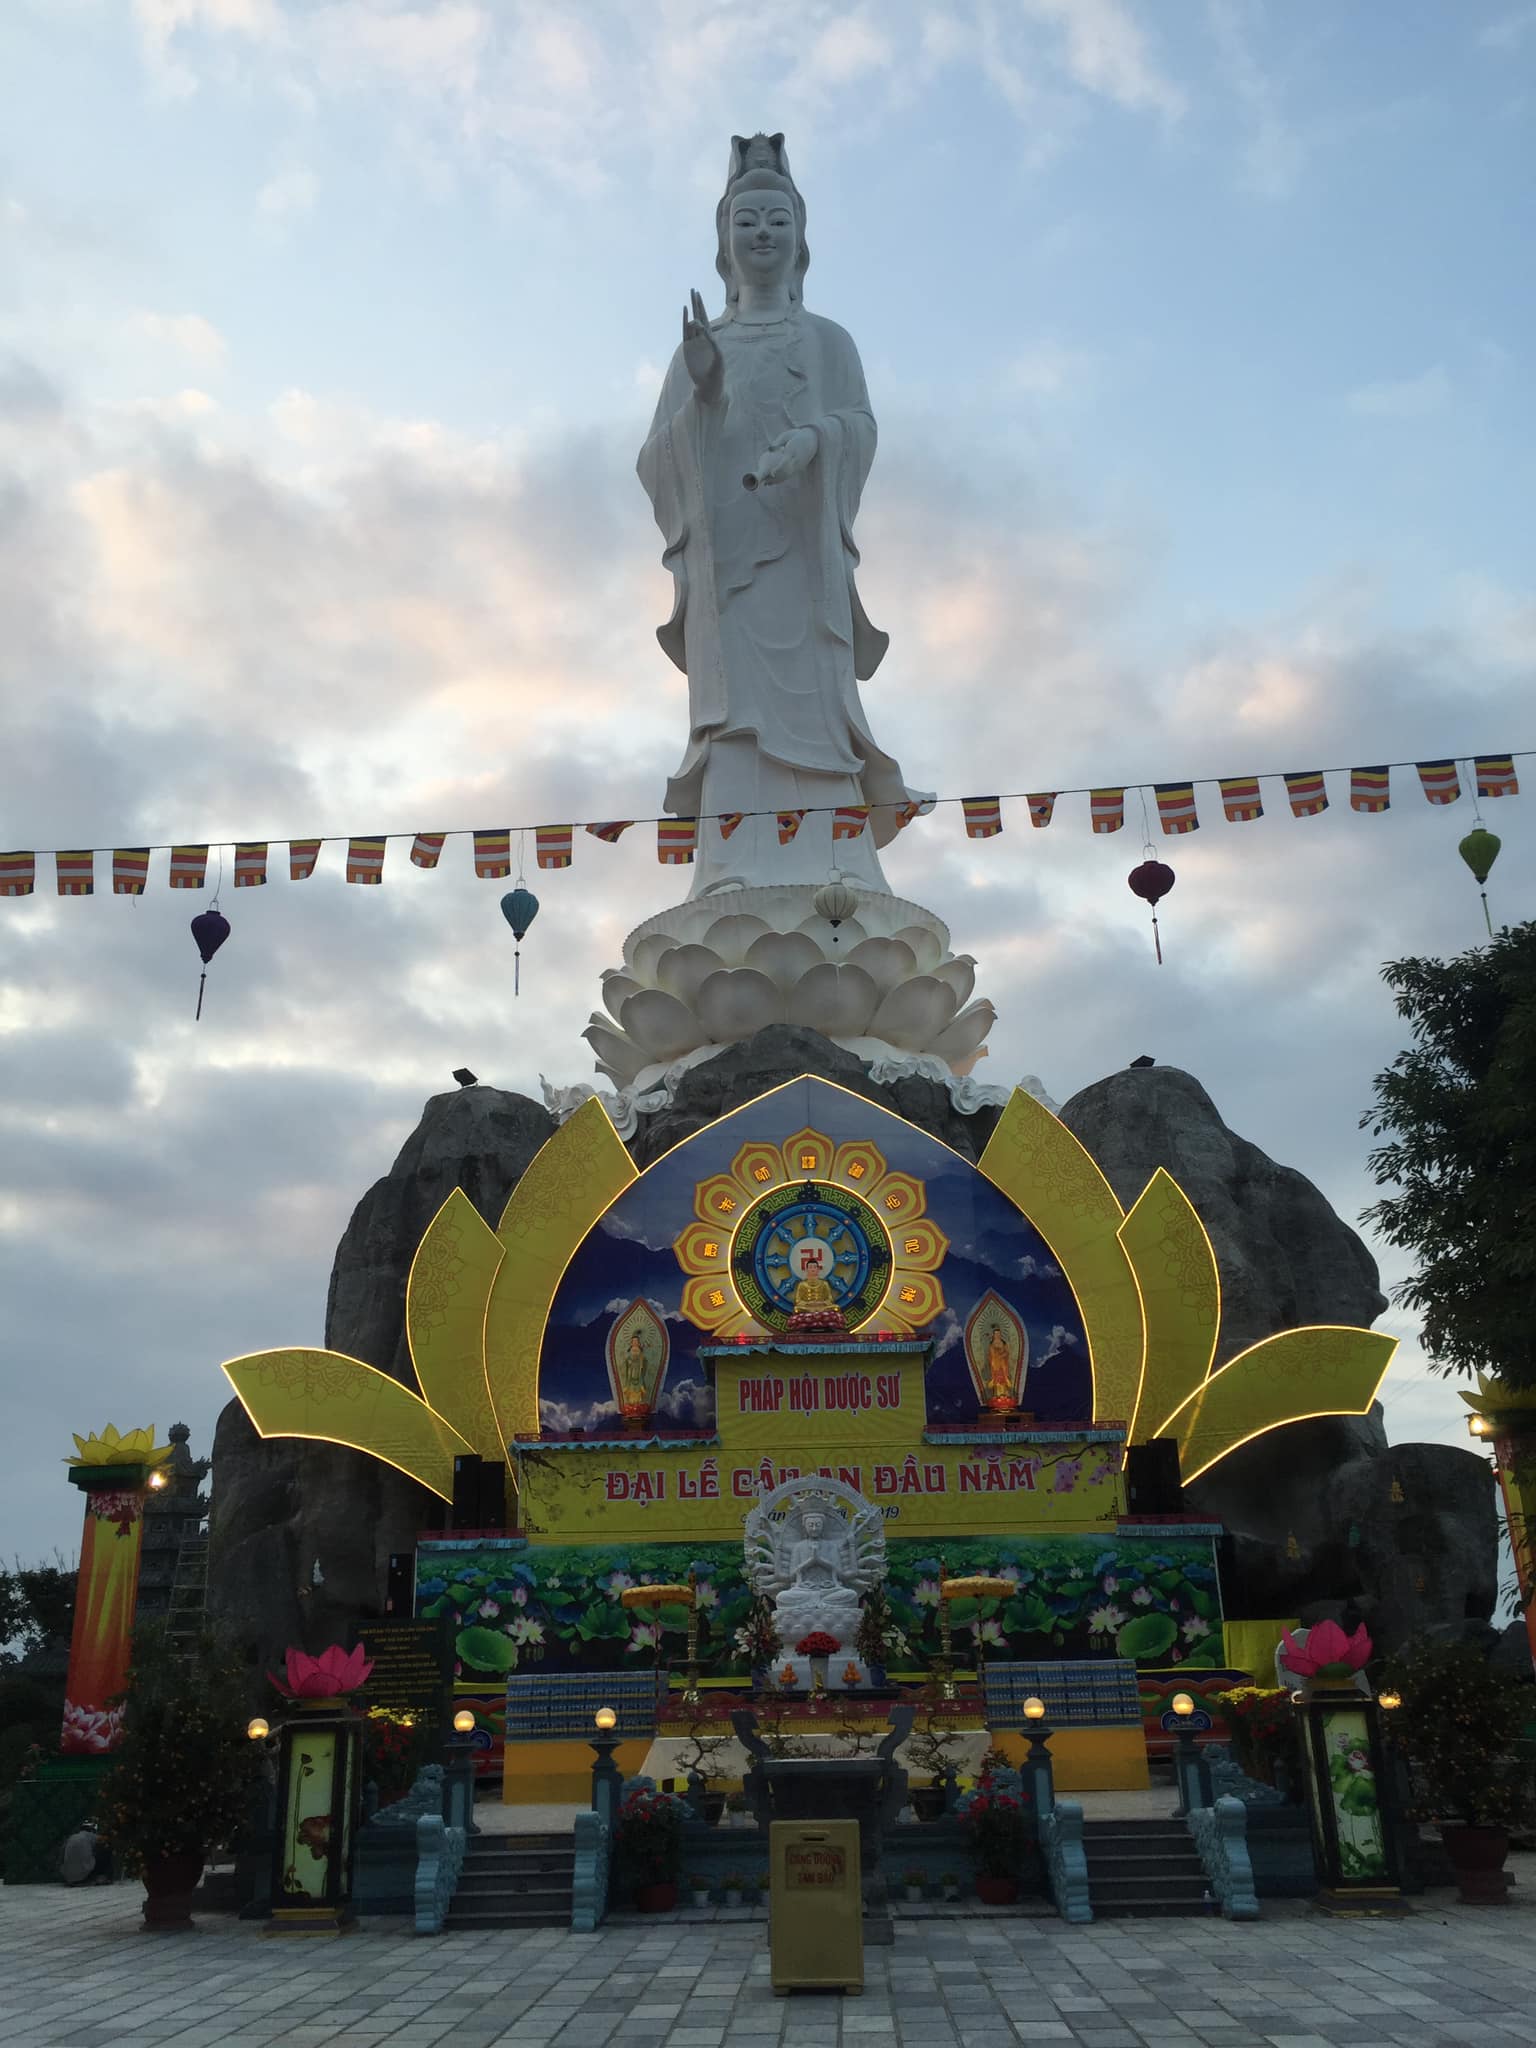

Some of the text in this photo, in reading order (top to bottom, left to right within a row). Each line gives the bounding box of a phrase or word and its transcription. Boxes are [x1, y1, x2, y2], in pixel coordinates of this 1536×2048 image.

[740, 1371, 900, 1416] PHÁP HỘI DƯỢC SƯ
[606, 1471, 664, 1506] ĐẠI
[679, 1458, 719, 1498] LỄ
[874, 1454, 946, 1493] ĐẦU
[960, 1456, 1035, 1491] NĂM
